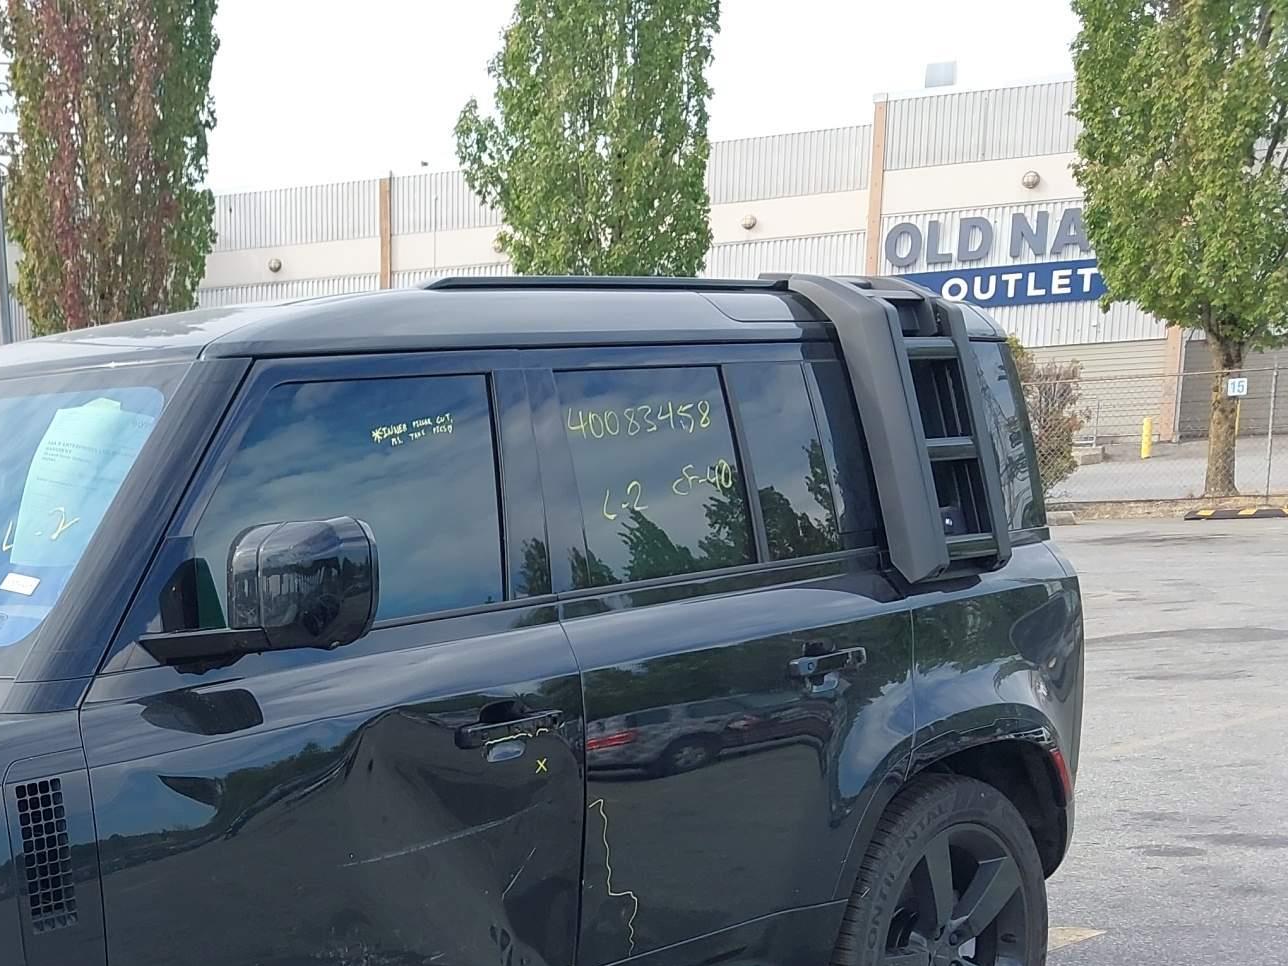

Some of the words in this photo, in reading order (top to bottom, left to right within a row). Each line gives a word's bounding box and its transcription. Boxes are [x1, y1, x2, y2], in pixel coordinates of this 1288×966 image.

[884, 216, 994, 268] OLD
[1009, 207, 1090, 259] NA
[941, 267, 1099, 301] OUTLET
[1230, 380, 1245, 394] 15
[566, 399, 713, 440] 40083458
